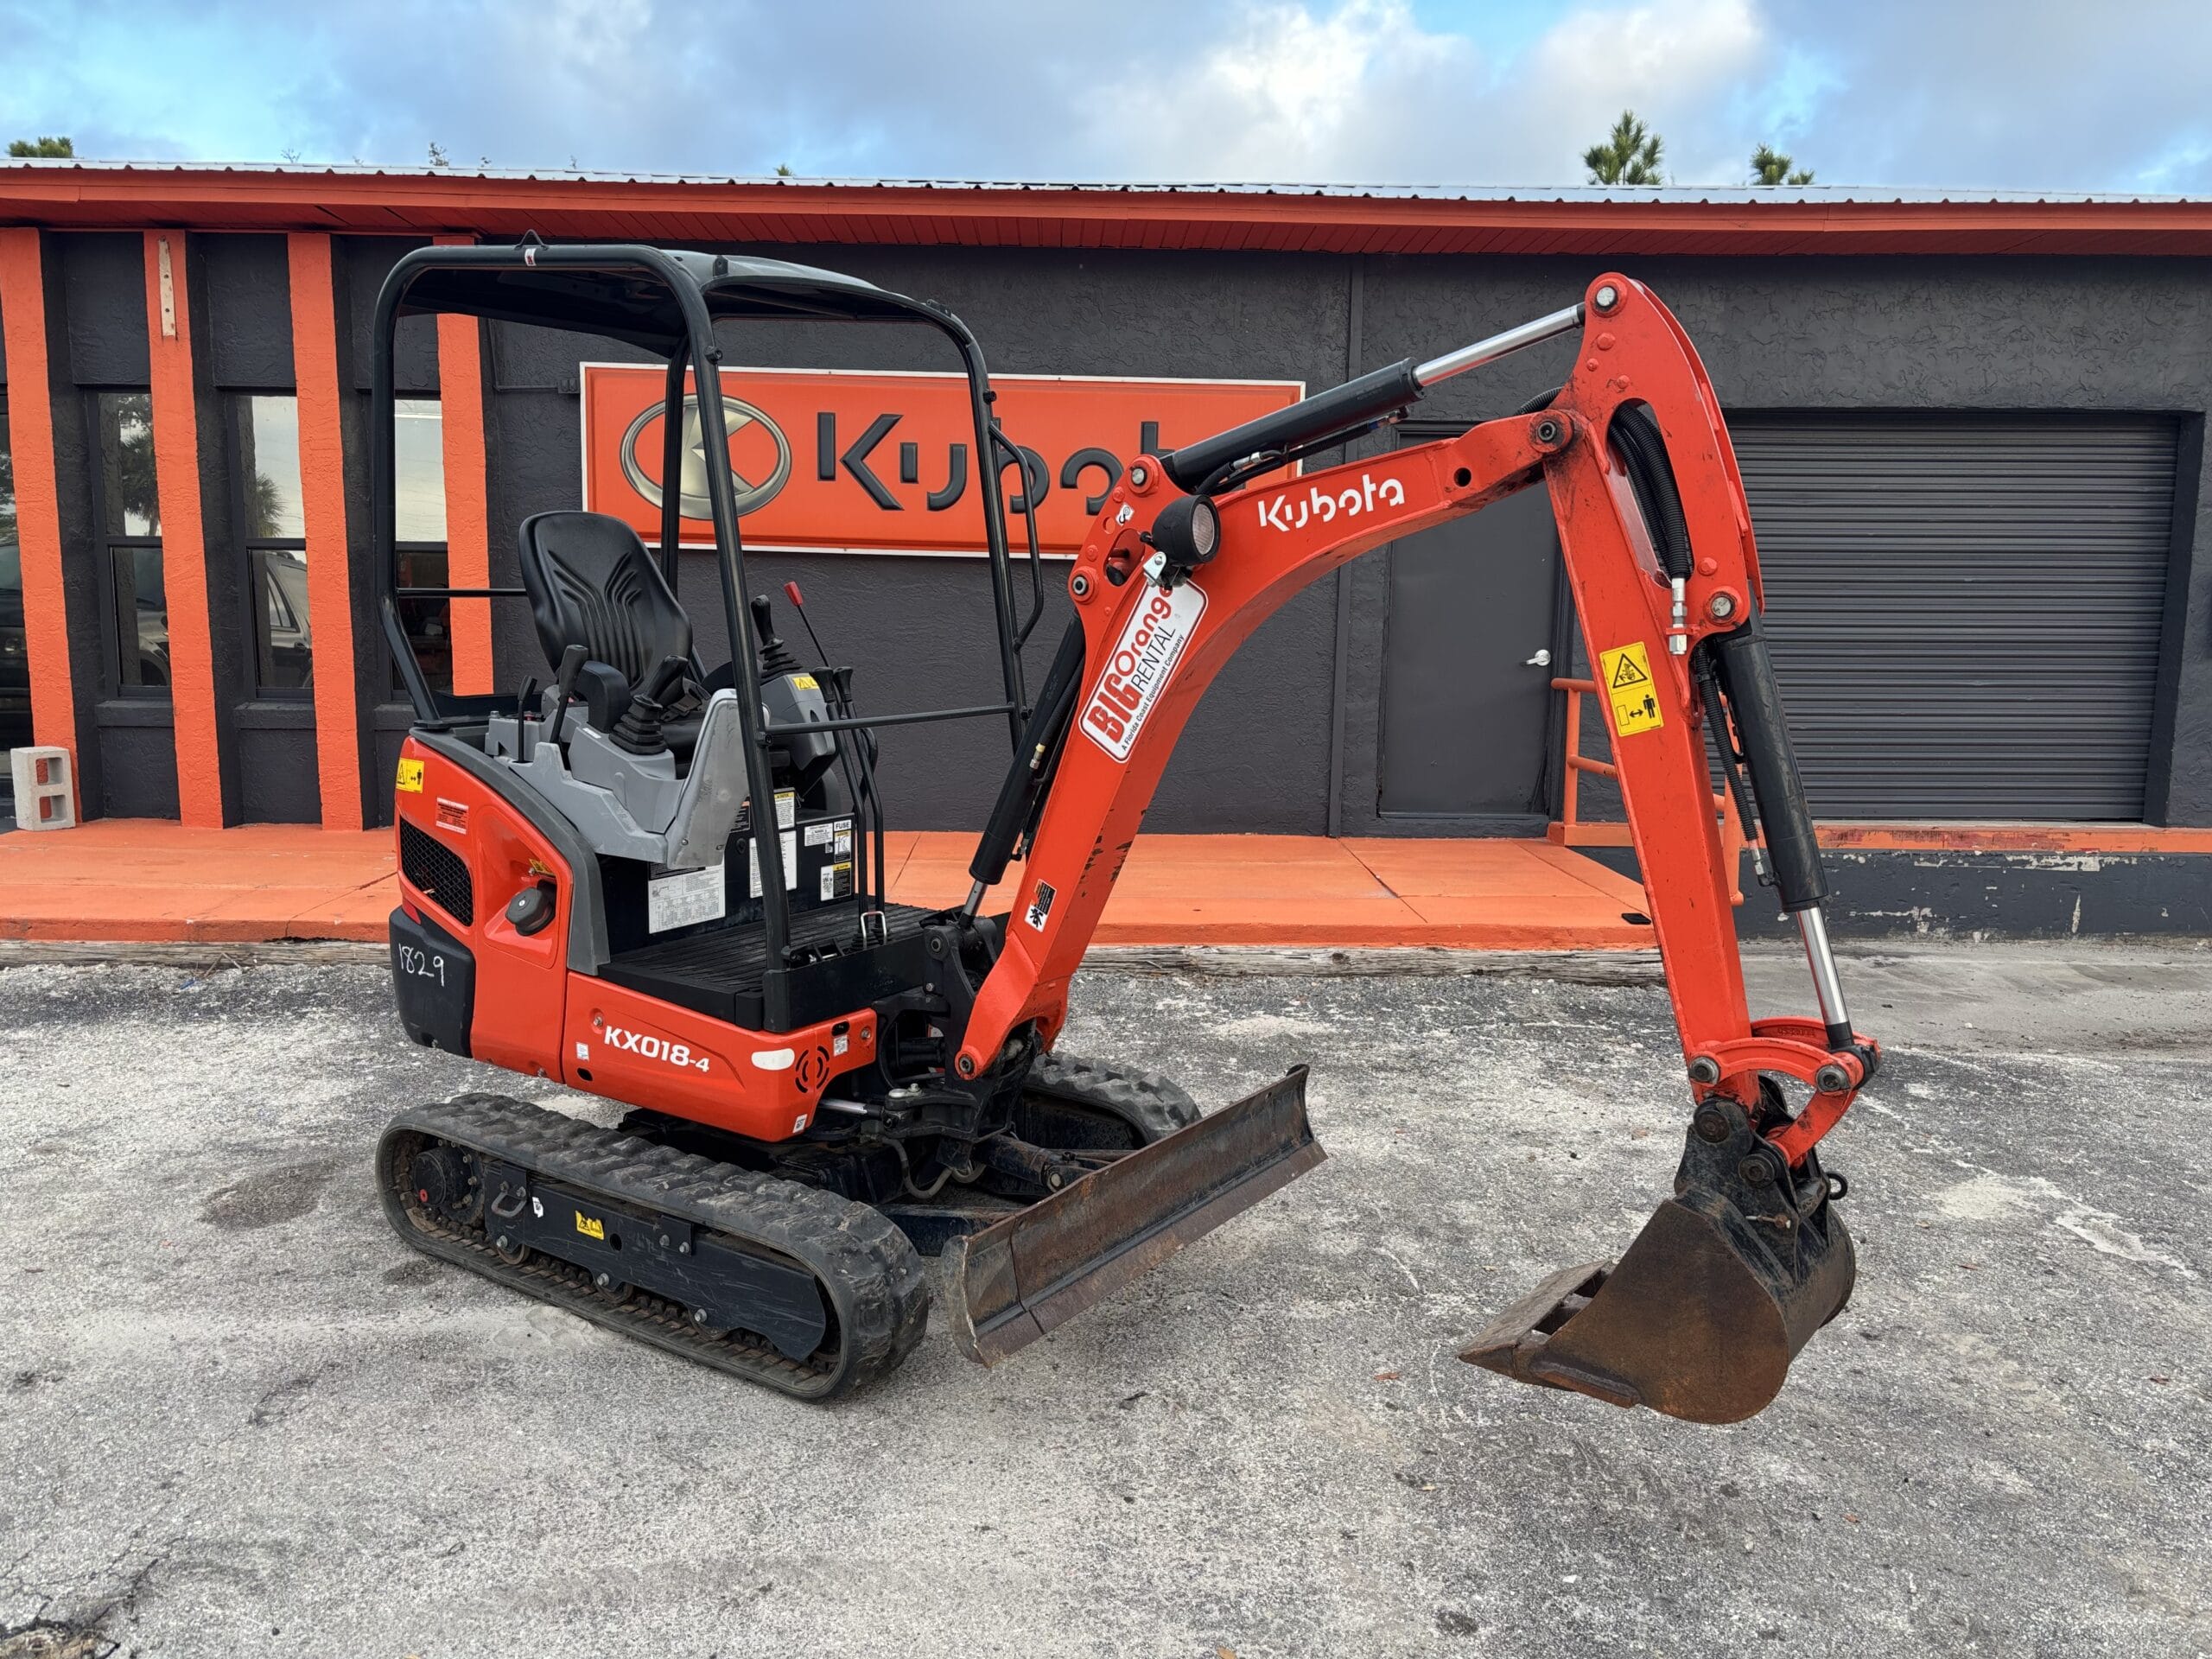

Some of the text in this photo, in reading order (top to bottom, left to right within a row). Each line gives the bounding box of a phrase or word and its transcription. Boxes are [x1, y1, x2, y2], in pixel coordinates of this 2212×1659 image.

[817, 412, 1246, 514] Kubo
[1257, 474, 1405, 532] Kubota
[1124, 721, 1140, 746] Florida
[1136, 702, 1149, 721] Coast
[1146, 666, 1168, 702] Equipment
[1165, 634, 1185, 666] Company
[1131, 626, 1176, 692] RENTAL
[1087, 673, 1143, 743] BIG
[836, 821, 850, 830] FUSE
[398, 943, 445, 987] 1829
[604, 1026, 710, 1072] KX018-4
